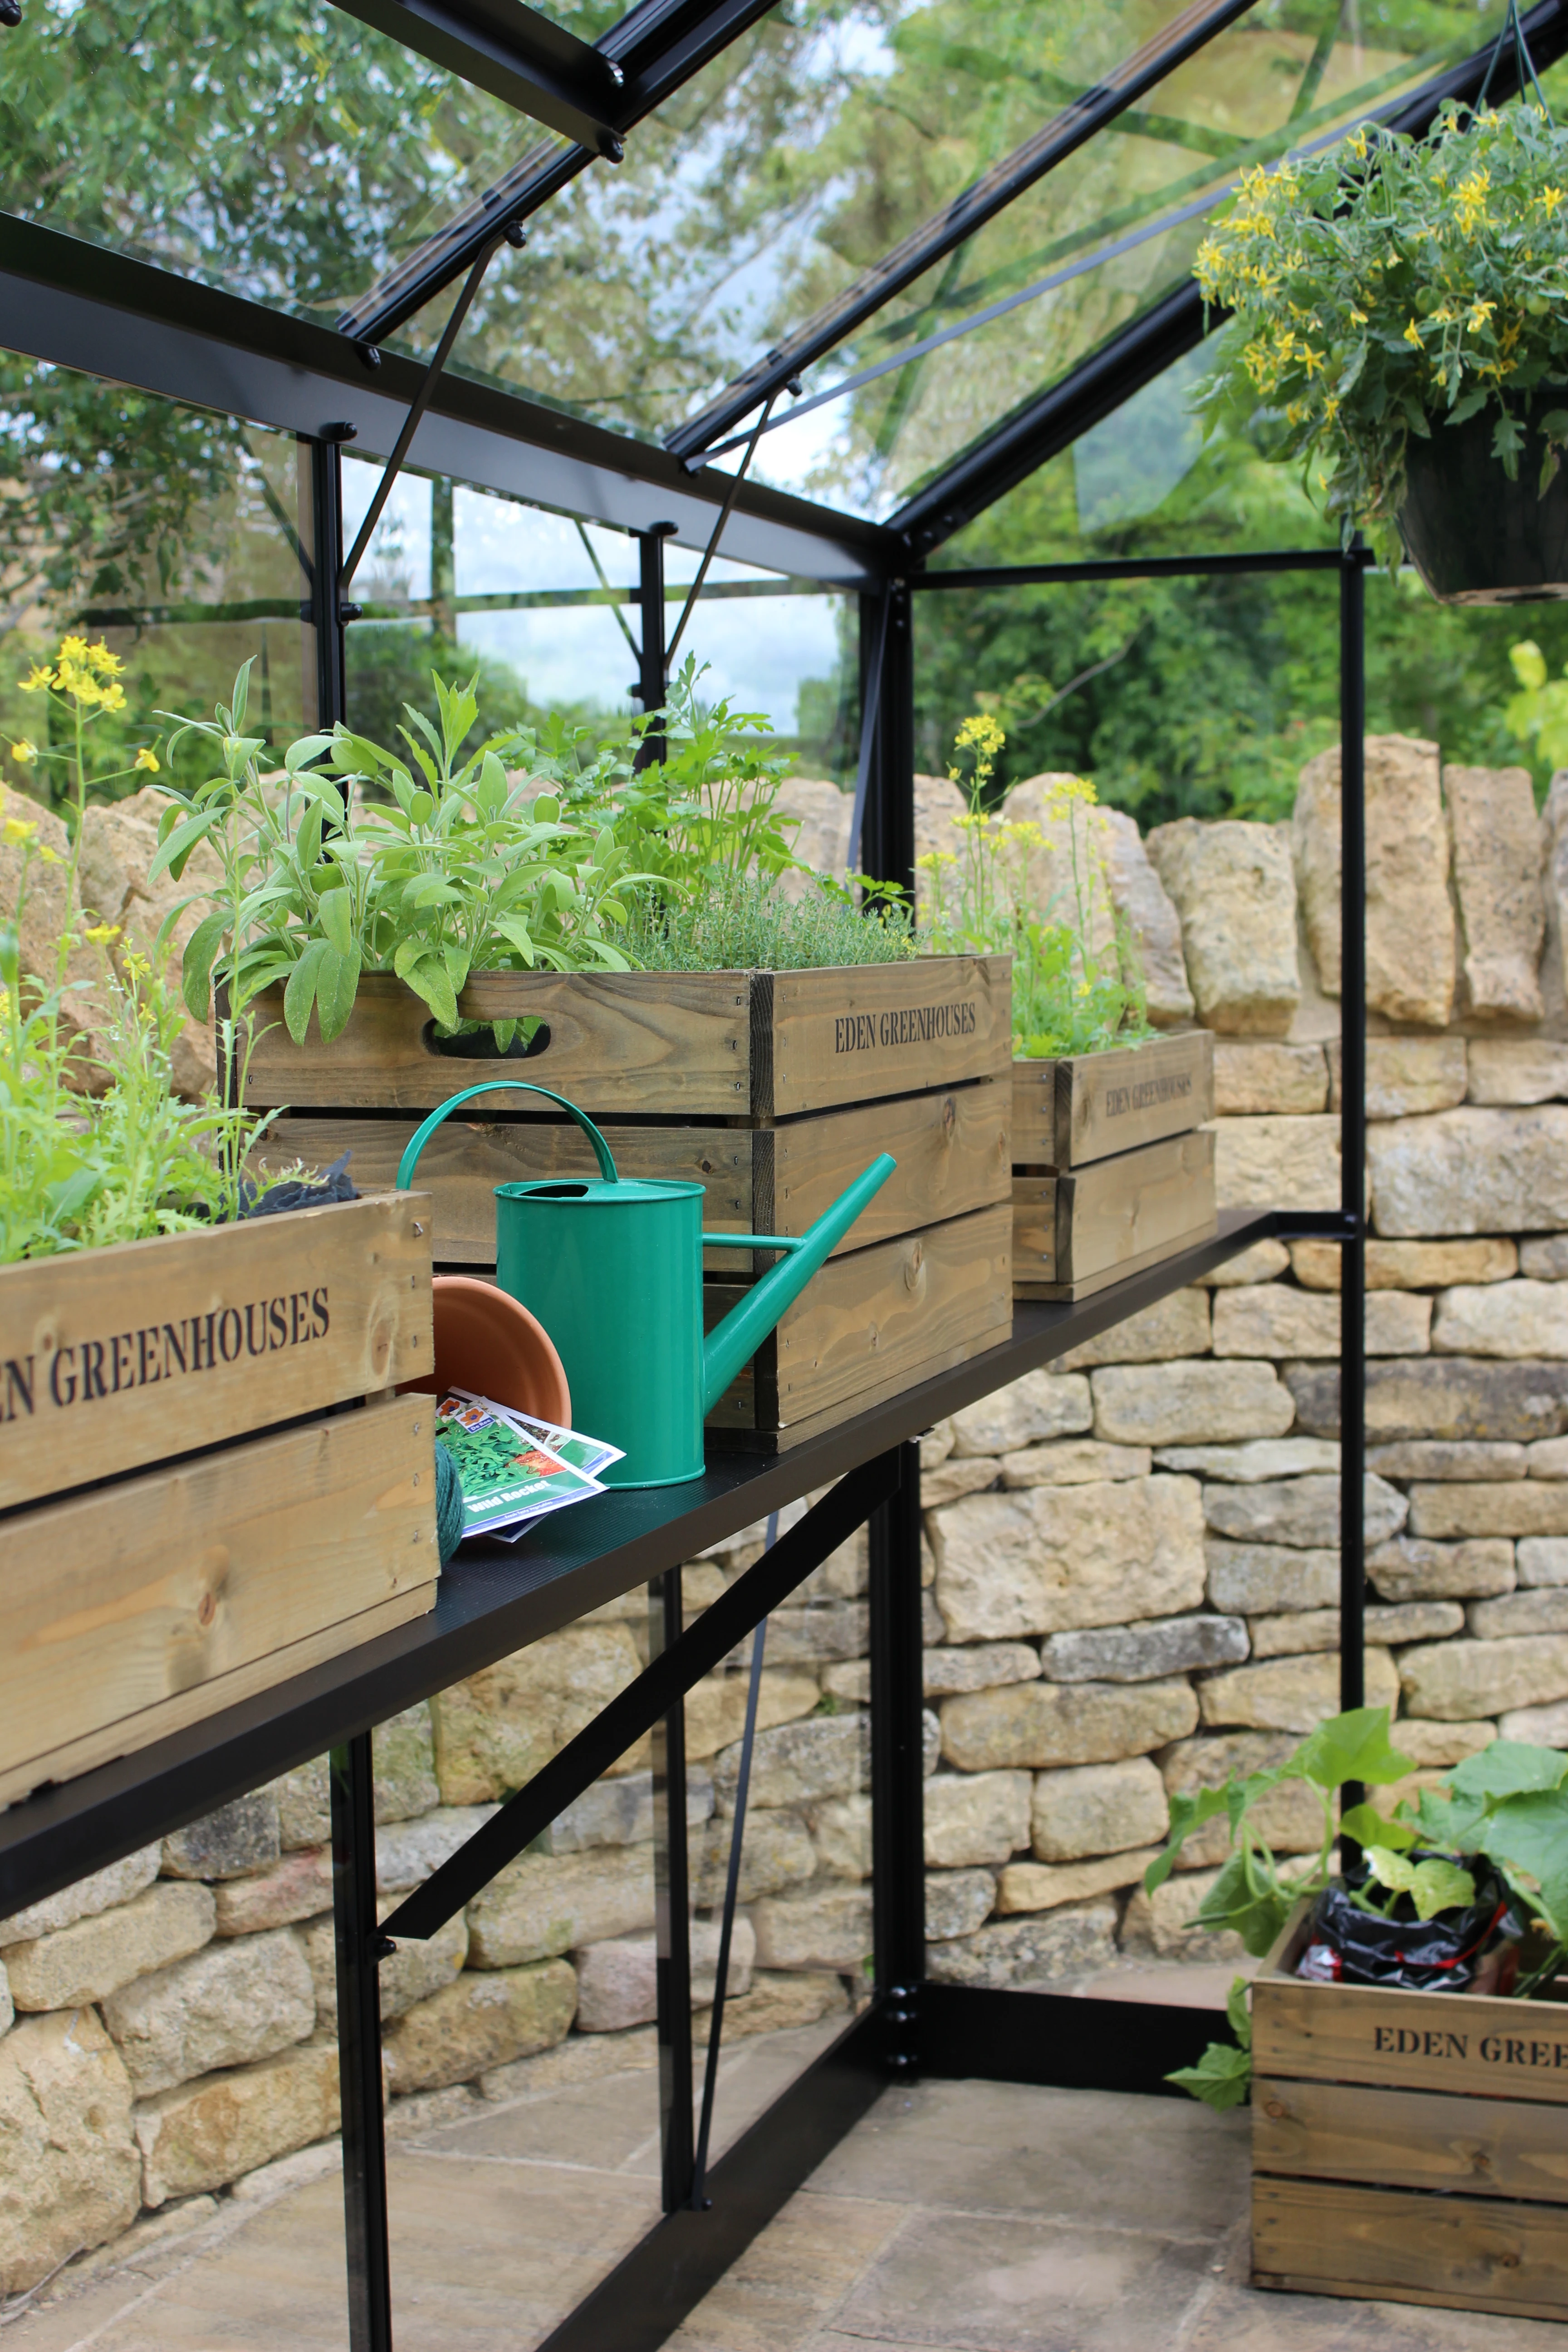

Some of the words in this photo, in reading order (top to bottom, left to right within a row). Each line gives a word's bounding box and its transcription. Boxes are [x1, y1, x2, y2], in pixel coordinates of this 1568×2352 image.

[835, 1014, 877, 1054] EDEN
[880, 1001, 975, 1047] GREENHOUSES
[49, 1287, 330, 1407] GREENHOUSES
[467, 1496, 504, 1513] Wild
[500, 1480, 552, 1502] Rocket
[1374, 2027, 1469, 2059] EDEN
